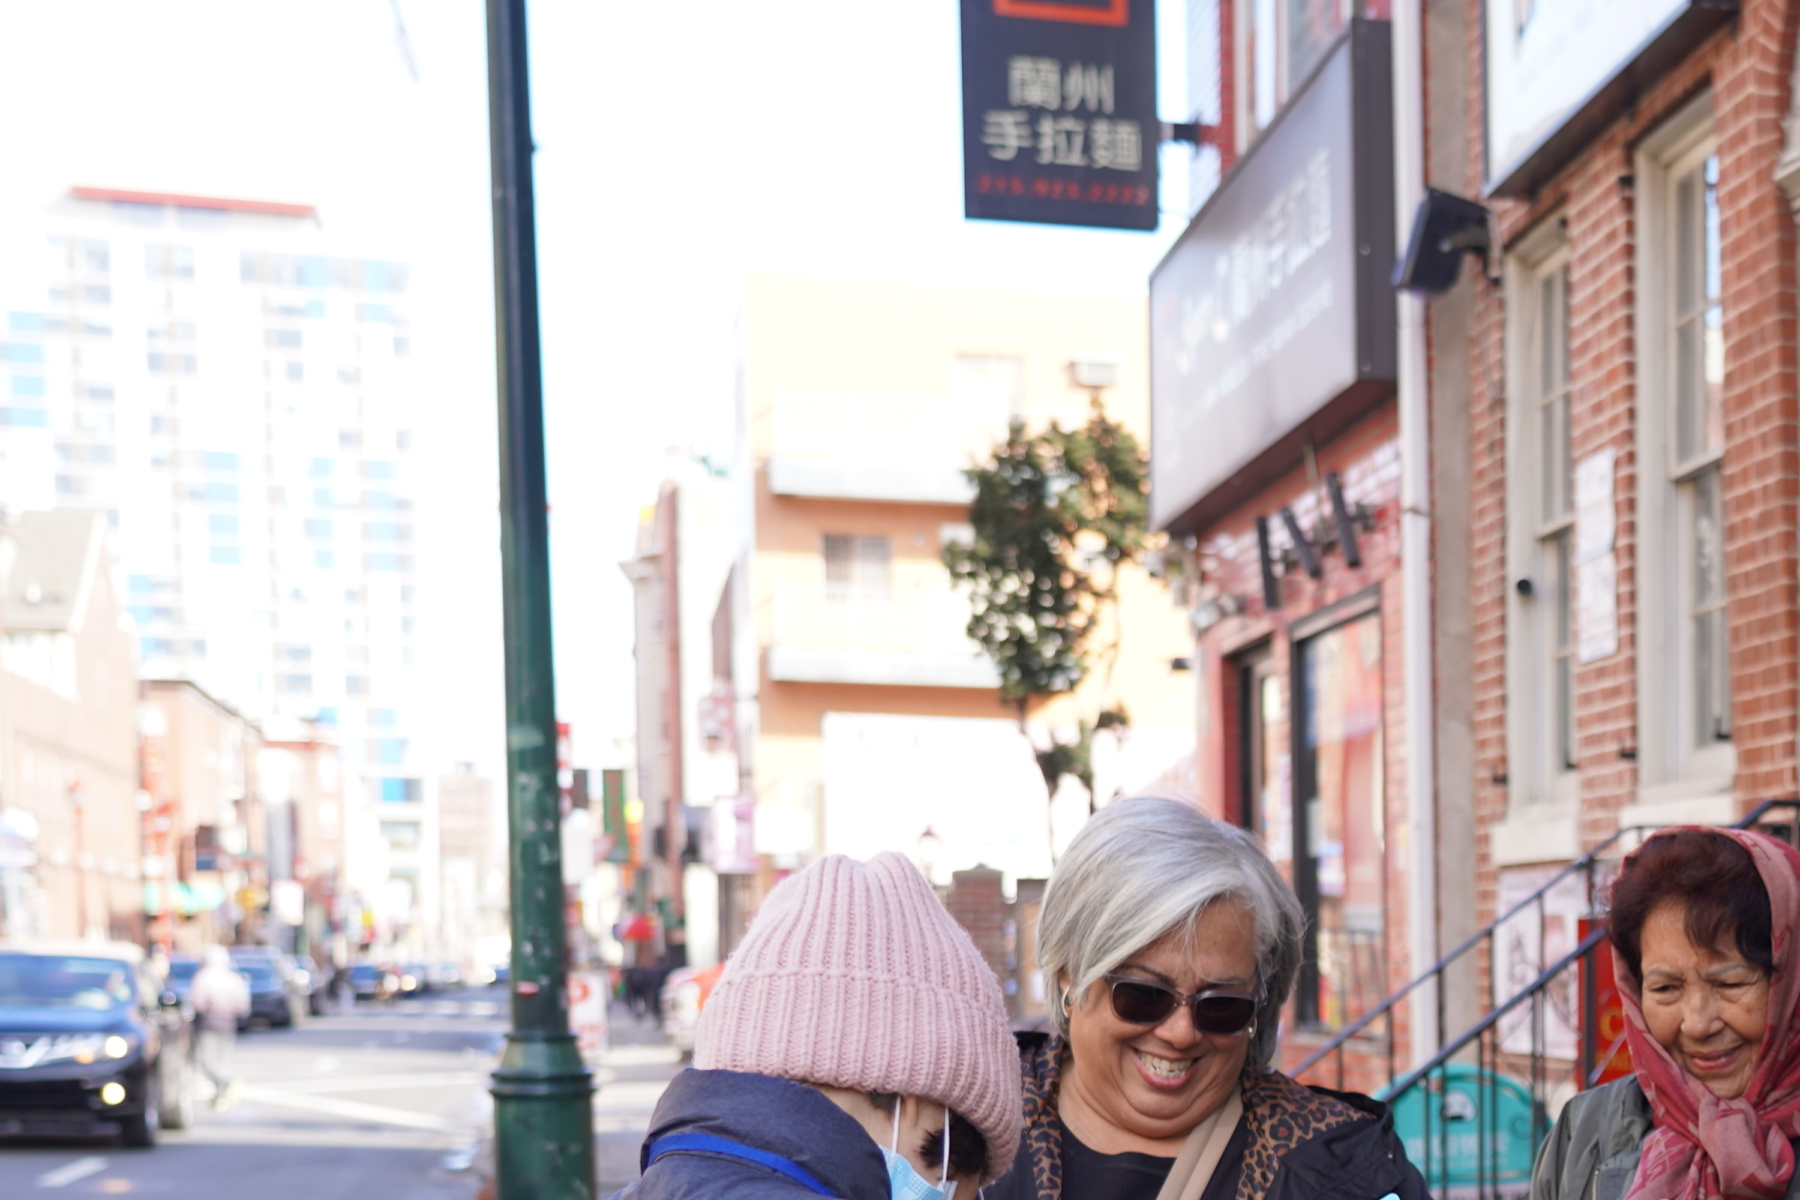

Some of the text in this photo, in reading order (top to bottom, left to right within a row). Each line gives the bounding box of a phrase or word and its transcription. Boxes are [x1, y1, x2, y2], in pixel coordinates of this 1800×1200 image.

[1008, 55, 1115, 115] 蘭州
[982, 110, 1142, 172] 手拉麵
